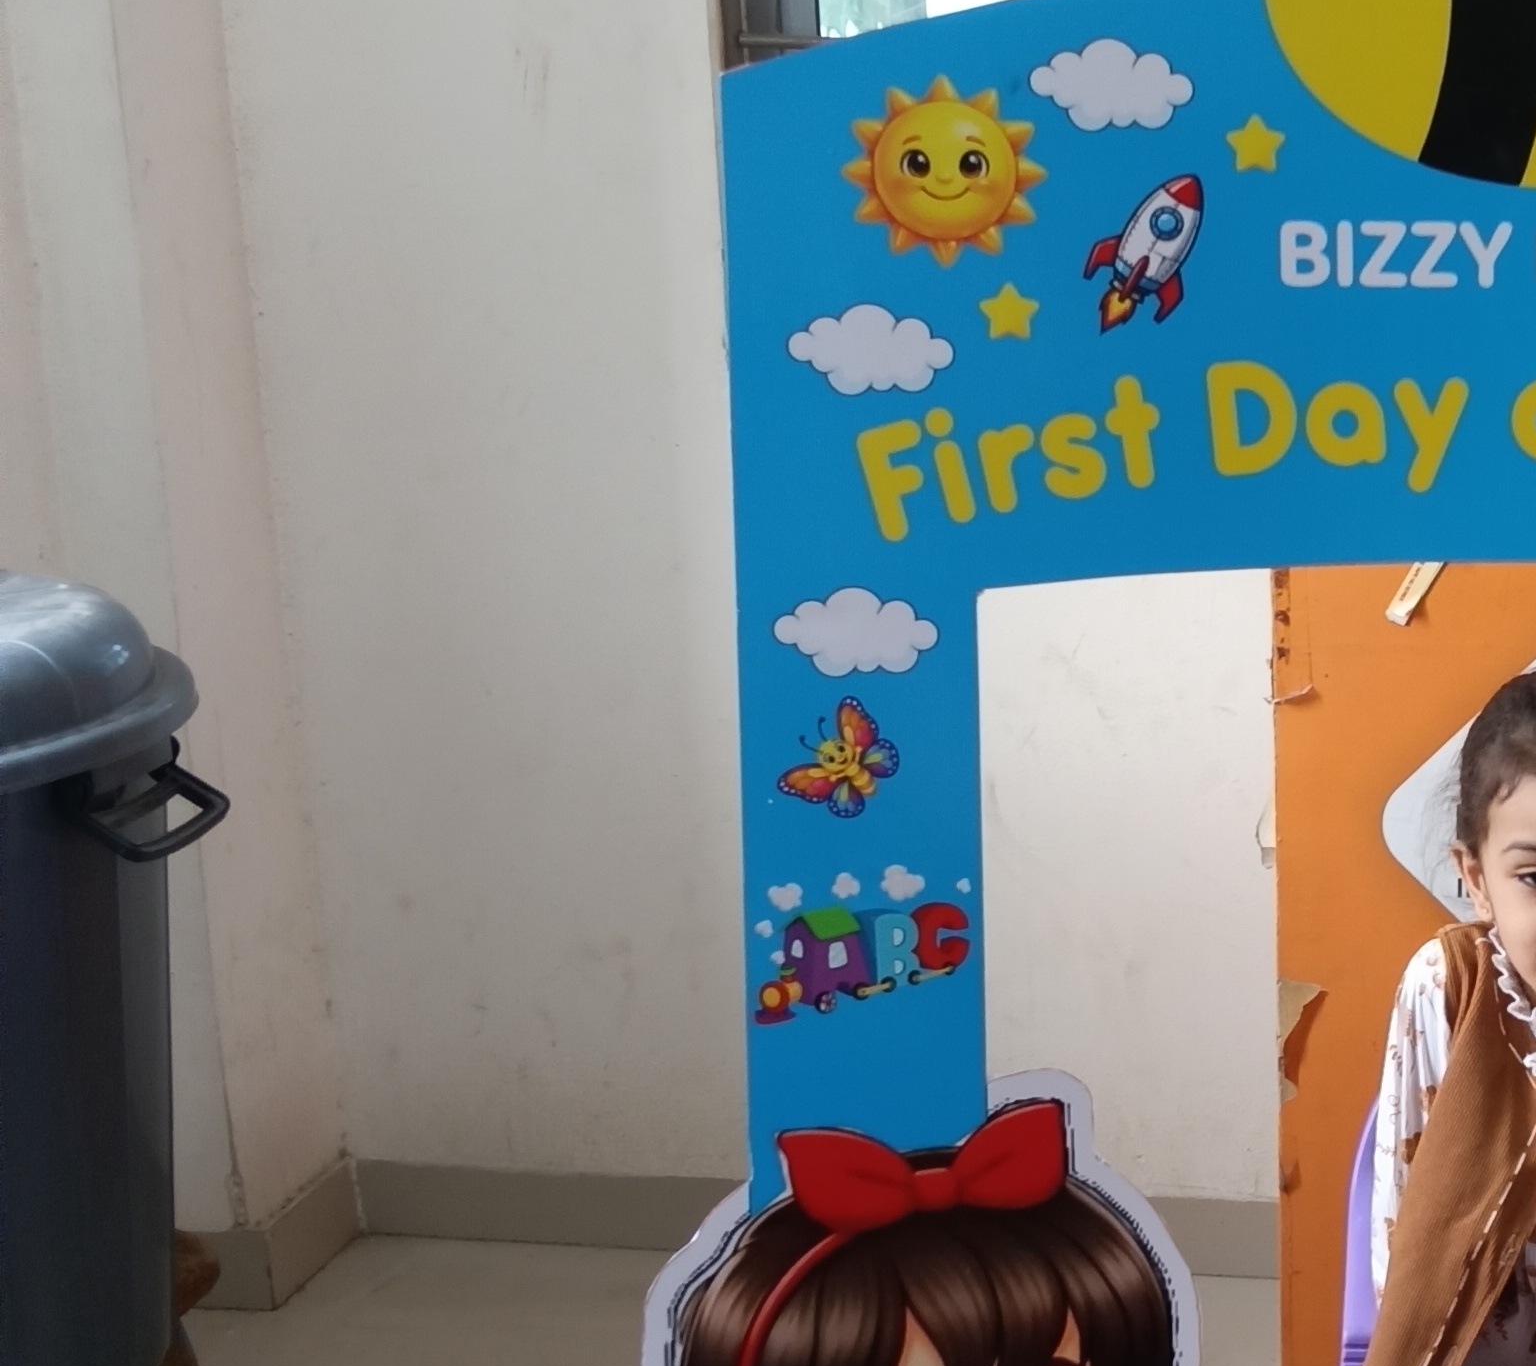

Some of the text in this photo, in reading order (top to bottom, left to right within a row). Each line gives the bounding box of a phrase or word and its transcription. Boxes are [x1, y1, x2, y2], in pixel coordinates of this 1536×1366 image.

[1279, 219, 1513, 289] BIZZY
[855, 374, 1161, 543] First
[1205, 360, 1470, 494] Day
